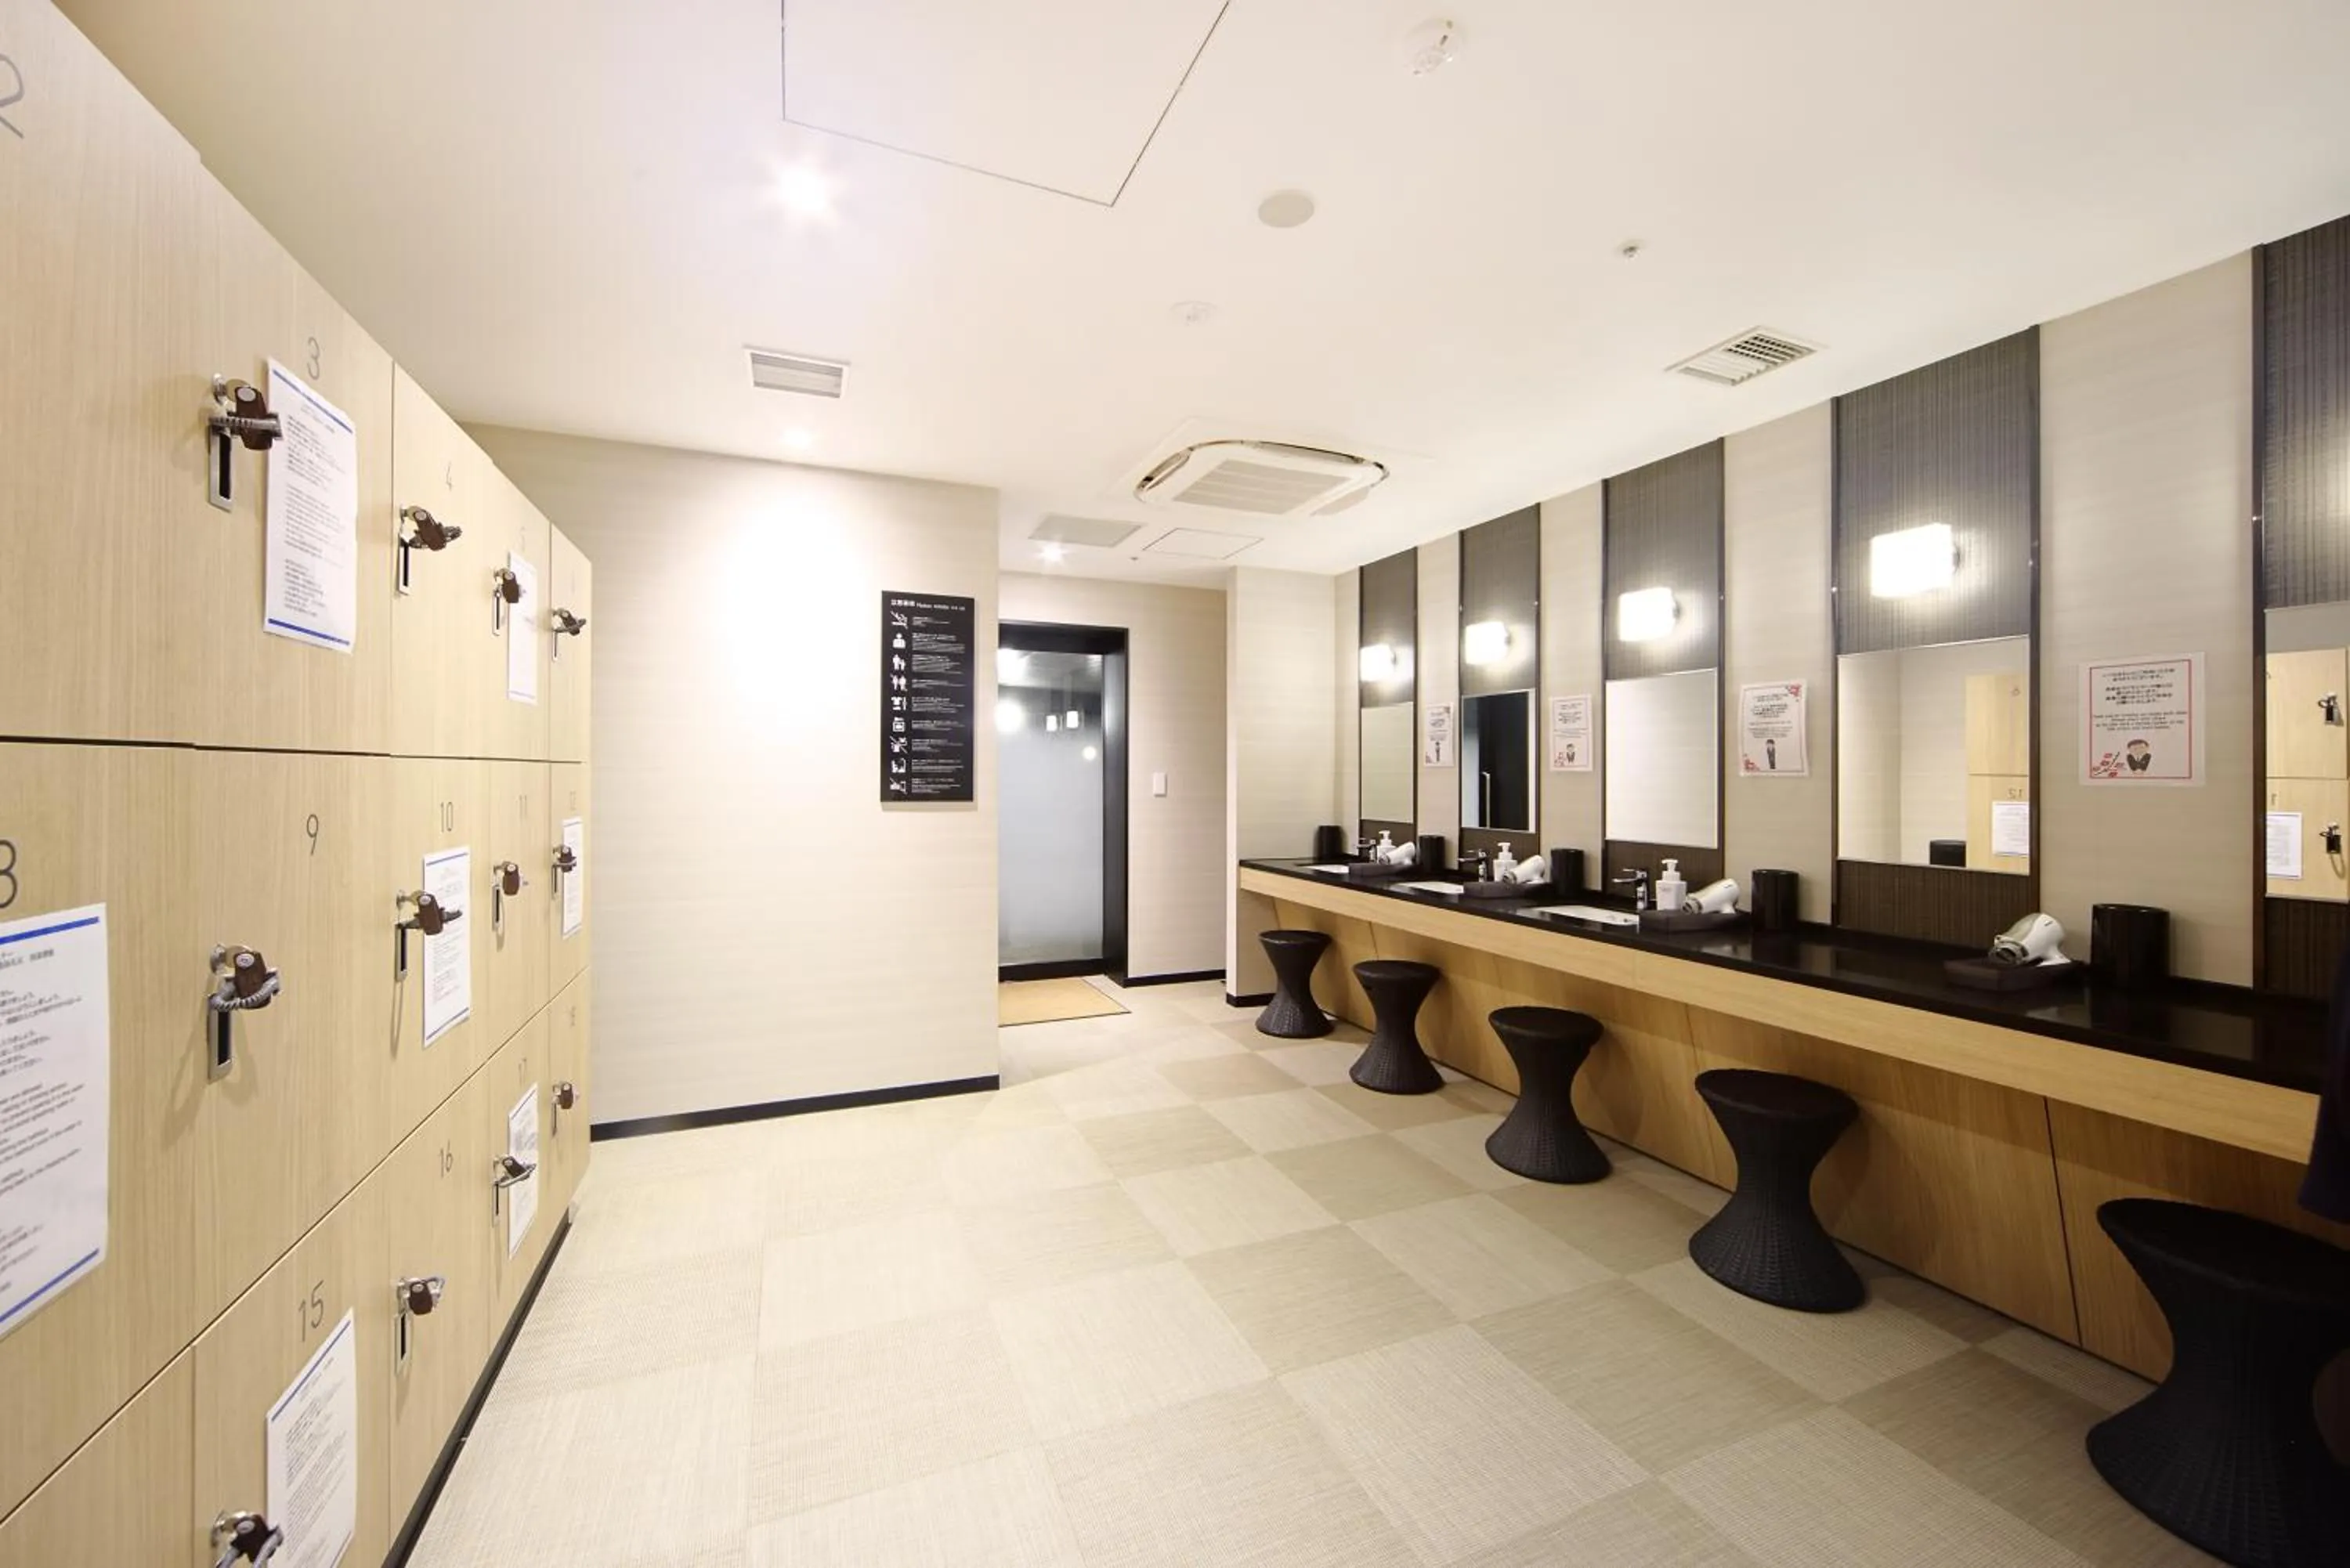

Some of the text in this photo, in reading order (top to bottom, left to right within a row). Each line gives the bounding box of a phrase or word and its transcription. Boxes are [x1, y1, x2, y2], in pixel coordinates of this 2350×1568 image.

[307, 337, 320, 381] 3
[306, 814, 319, 856] 9
[440, 801, 454, 833] 10
[439, 1139, 454, 1179] 16
[298, 1280, 324, 1342] 15
